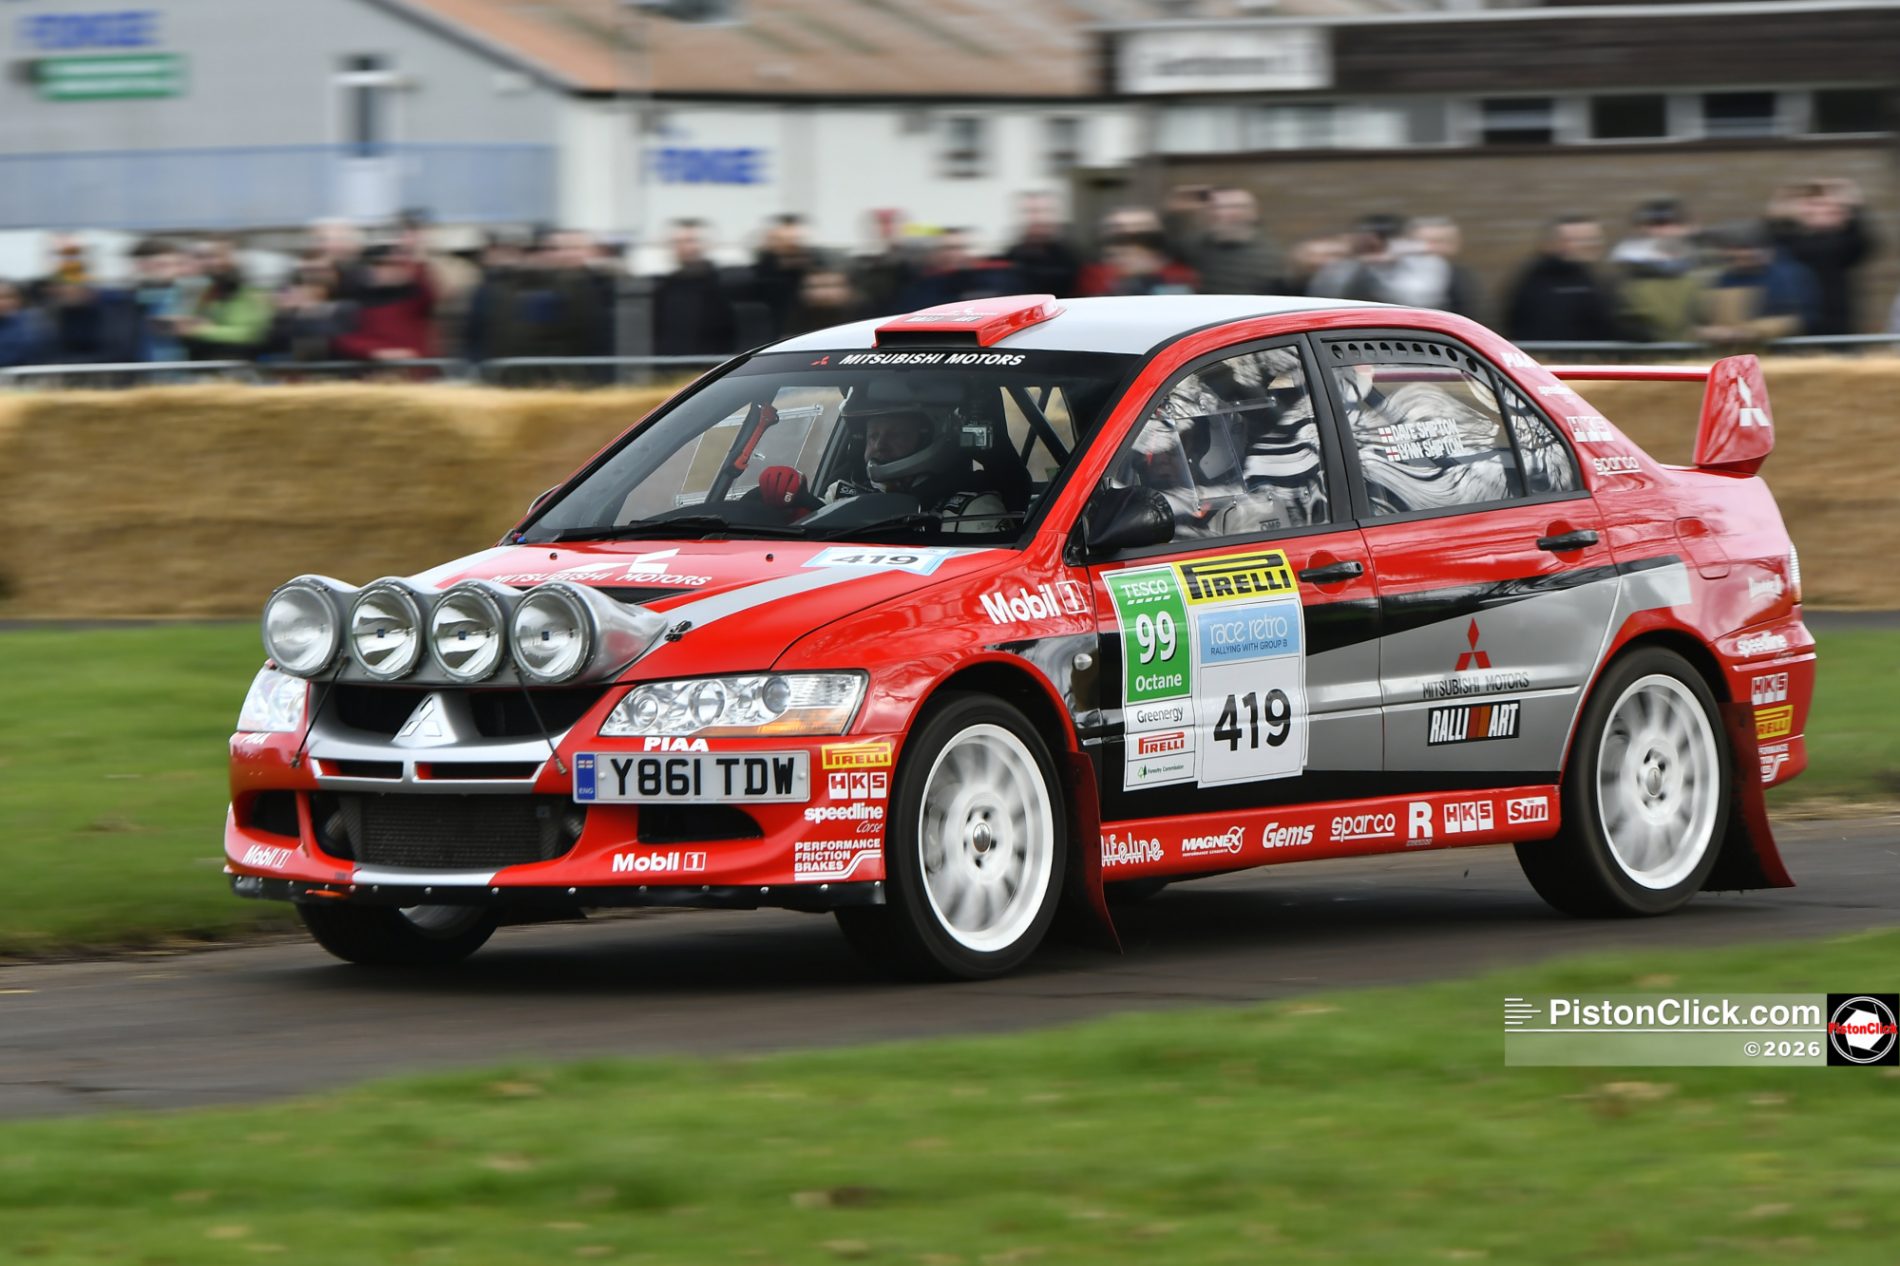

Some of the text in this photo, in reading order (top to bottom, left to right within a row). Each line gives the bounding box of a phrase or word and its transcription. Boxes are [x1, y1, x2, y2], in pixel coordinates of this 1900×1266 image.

[838, 353, 1026, 366] MITSUBISHI MOTORS
[831, 555, 919, 565] 419
[491, 571, 712, 586] MITSUBISHI MOTORS
[1180, 554, 1292, 599] PIRELLI
[1121, 579, 1169, 598] TESCO
[979, 584, 1061, 625] Mobil
[1136, 611, 1176, 664] 99
[1210, 614, 1288, 645] race retro
[1210, 639, 1288, 656] RALLYING WITH GROUP B
[1136, 673, 1182, 692] Octane
[1423, 672, 1530, 698] MITSUBISHI MOTORS
[1752, 673, 1788, 700] HKS
[1137, 707, 1184, 723] Greenergy
[1213, 689, 1292, 751] 419
[643, 736, 709, 752] PIAA
[1138, 732, 1185, 755] PIRELLI
[823, 745, 890, 767] PIRELLI
[716, 757, 795, 796] TDW
[829, 773, 886, 795] HKS
[578, 787, 594, 795] ENG
[804, 802, 883, 824] speedline
[1408, 801, 1433, 839] R
[1444, 801, 1493, 829] HKS
[1510, 801, 1546, 821] Sun
[856, 821, 882, 833] Corse
[1262, 822, 1315, 849] Gems
[1330, 813, 1396, 842] sparco
[795, 838, 881, 851] PERFORMANCE
[1101, 832, 1164, 867] lifeline
[1182, 827, 1245, 854] MAGNEX
[242, 845, 279, 867] Mobil
[612, 853, 679, 872] Mobil
[795, 851, 850, 862] FRICTION
[795, 861, 844, 872] BRAKES
